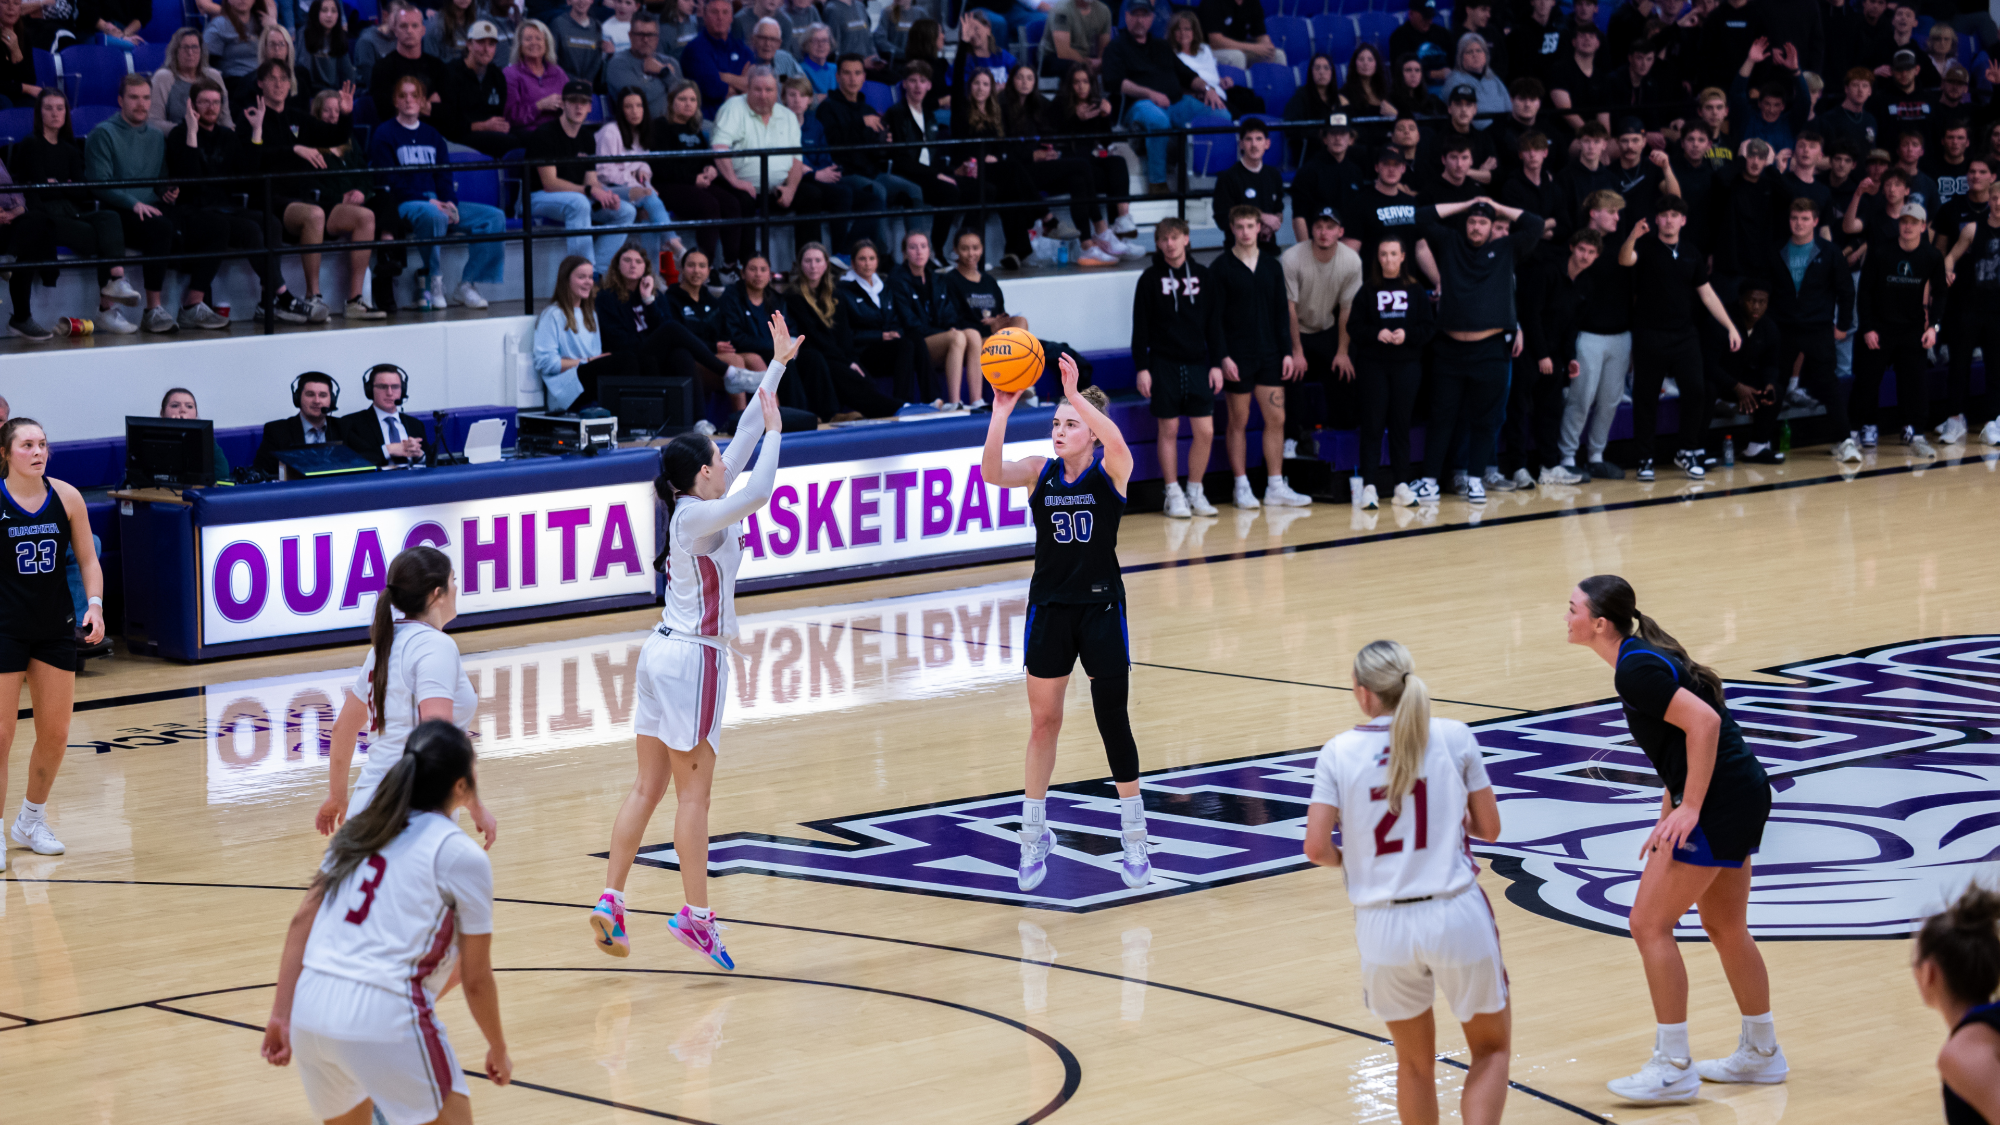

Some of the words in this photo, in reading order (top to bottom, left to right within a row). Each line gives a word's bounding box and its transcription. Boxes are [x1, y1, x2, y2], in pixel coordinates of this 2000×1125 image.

[742, 464, 1036, 560] ASKETBAL
[1044, 493, 1097, 506] OUACHITA
[8, 522, 61, 538] OUACHITA
[1051, 510, 1094, 544] 30
[15, 538, 58, 575] 23
[1370, 777, 1428, 857] 21
[345, 854, 387, 925] 3
